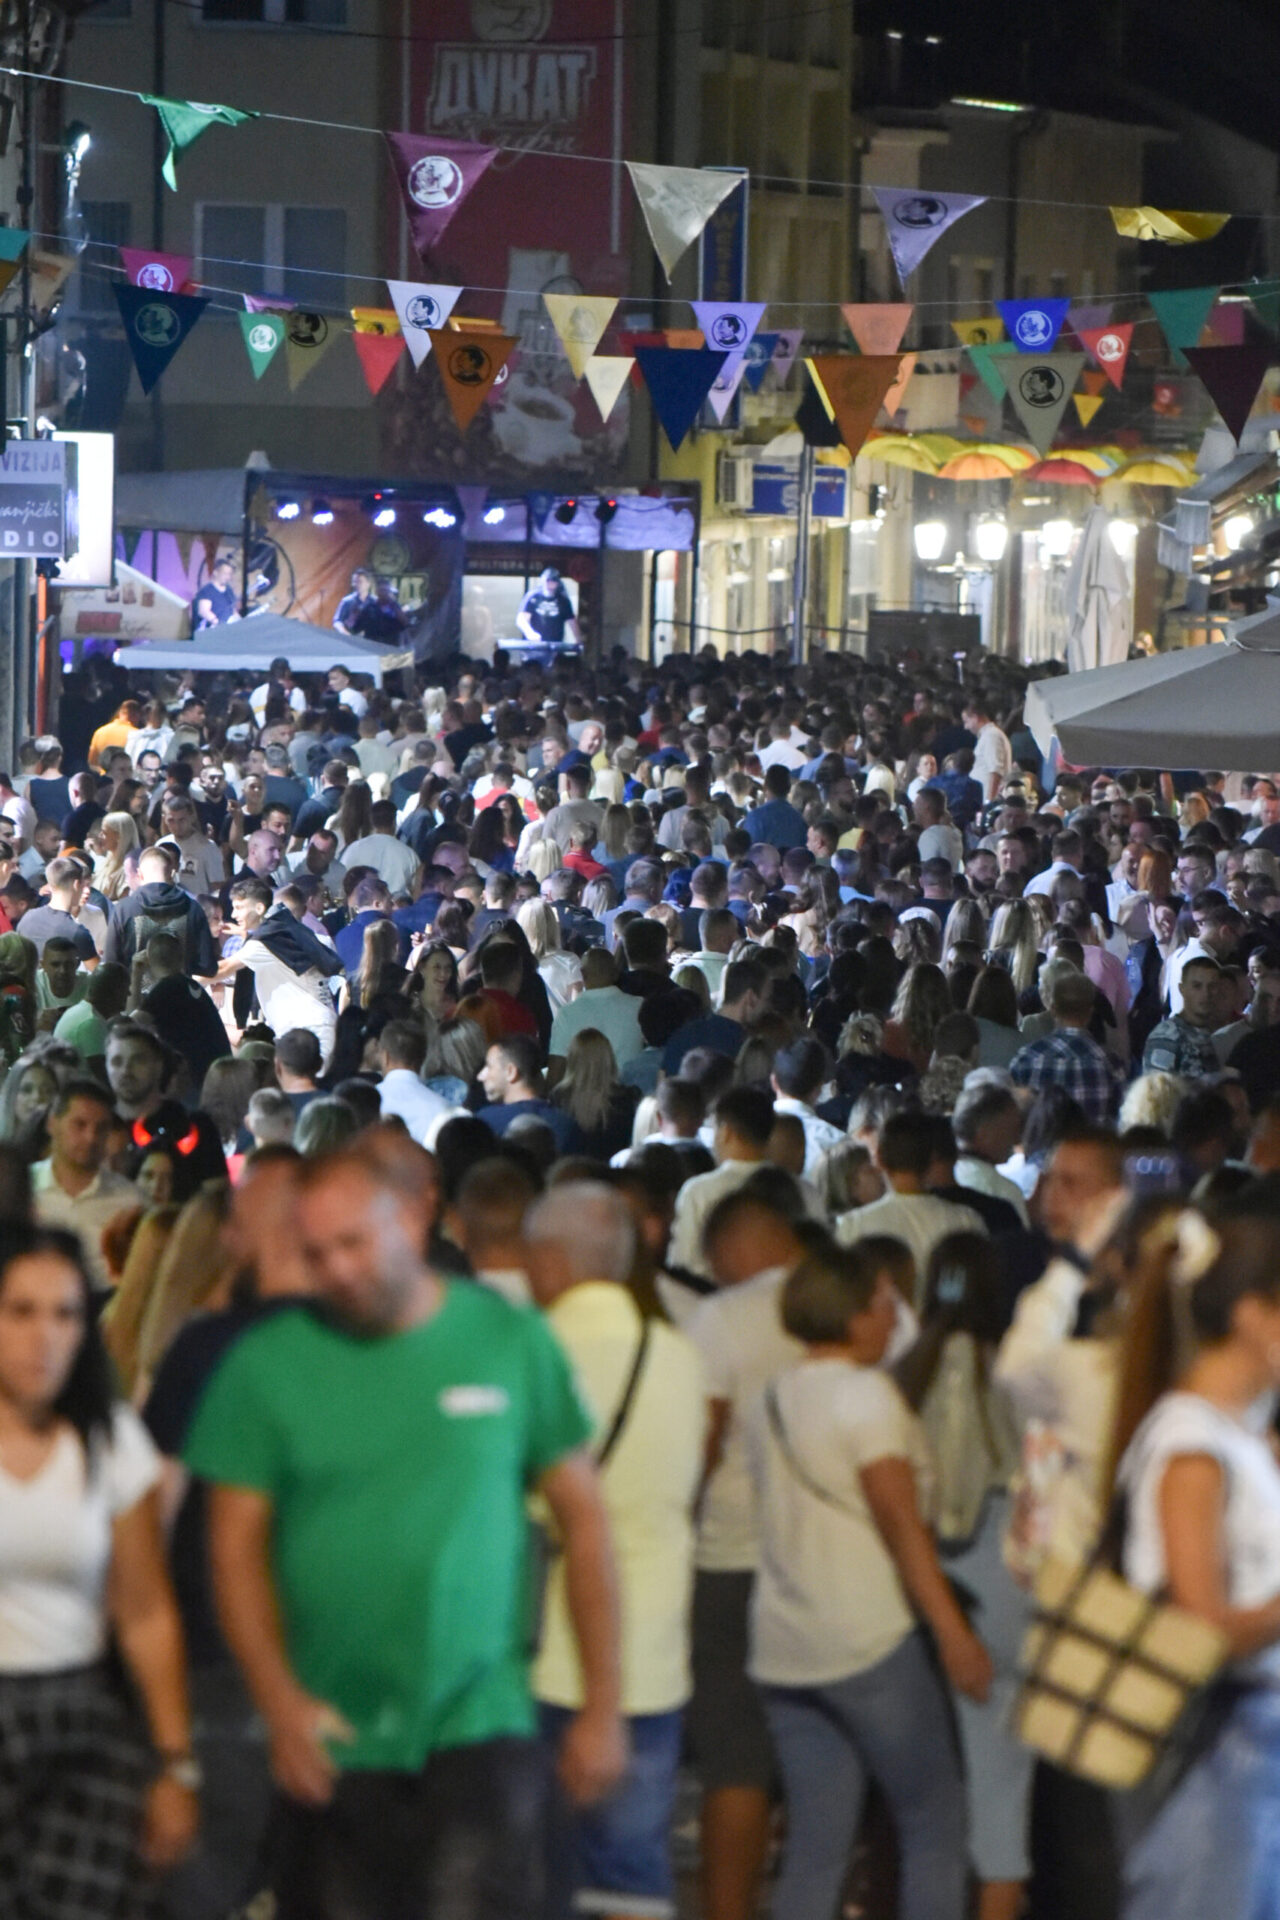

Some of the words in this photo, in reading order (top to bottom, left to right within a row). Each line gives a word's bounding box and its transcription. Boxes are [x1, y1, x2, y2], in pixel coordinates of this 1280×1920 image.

[432, 50, 587, 124] ДУКАТ
[1, 451, 62, 472] VIZIJA
[4, 530, 59, 547] DIO
